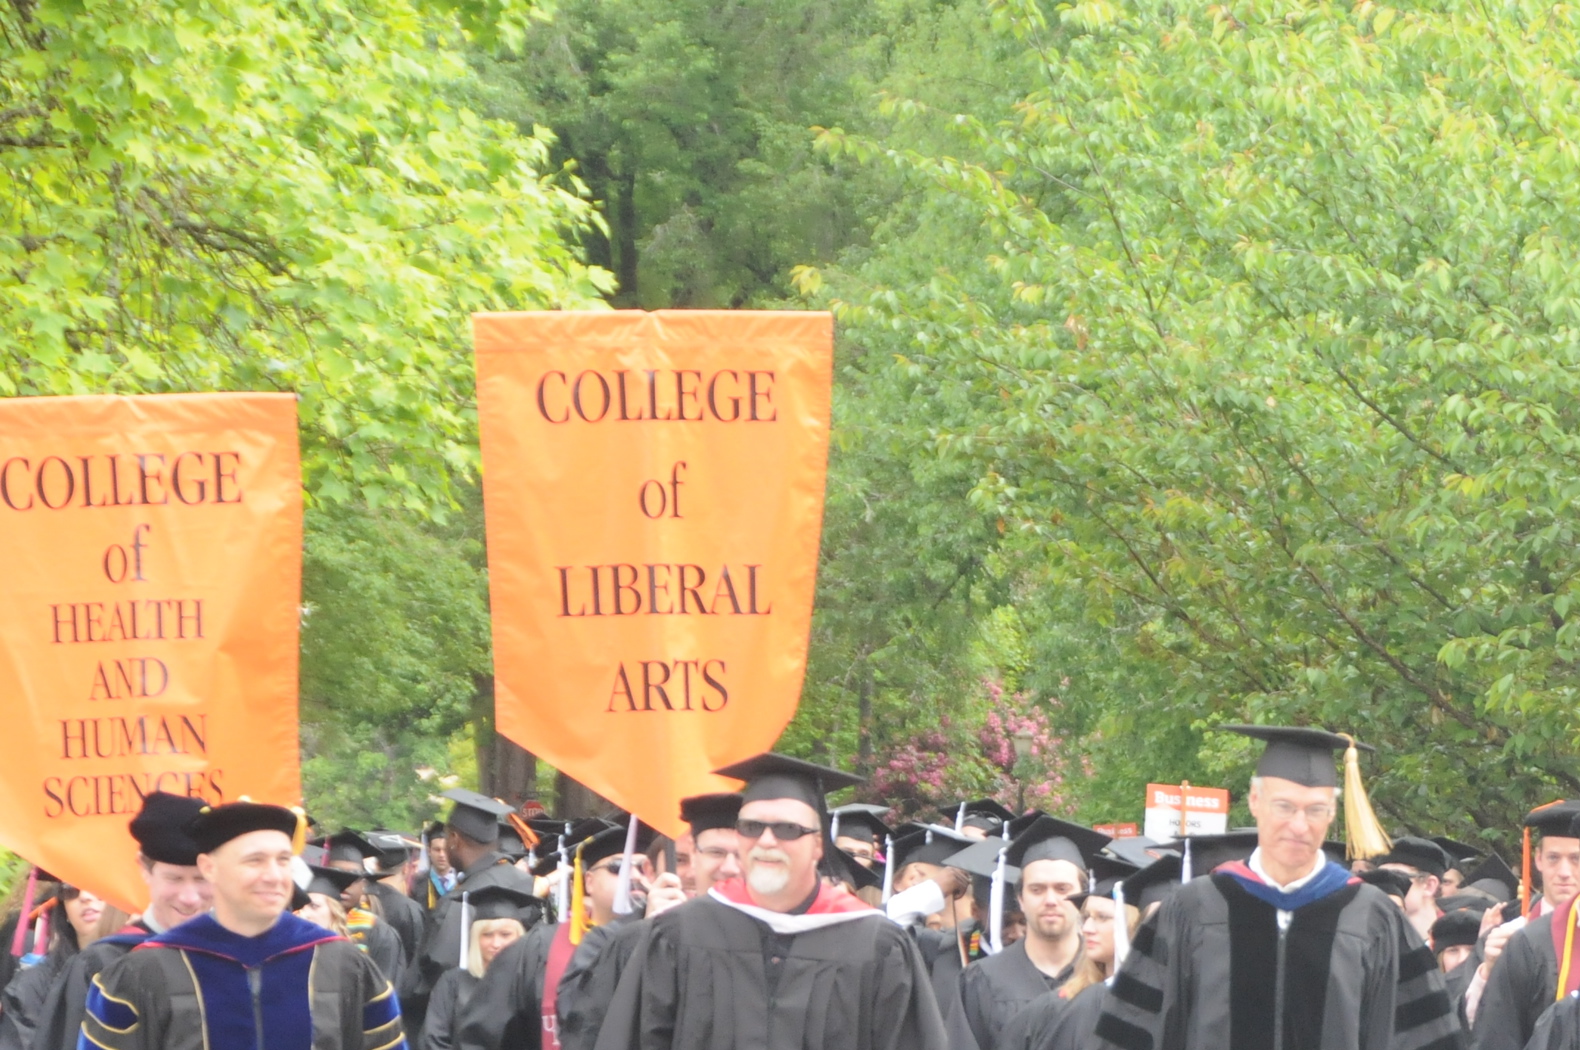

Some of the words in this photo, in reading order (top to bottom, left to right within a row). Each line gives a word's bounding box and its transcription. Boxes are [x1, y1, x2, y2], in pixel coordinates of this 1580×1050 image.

[534, 368, 778, 424] COLLEGE
[0, 451, 243, 511] COLLEGE
[637, 460, 688, 519] of
[102, 523, 152, 584] of
[554, 563, 773, 618] LIBERAL
[49, 598, 205, 645] HEALTH
[88, 656, 170, 702] AND
[604, 657, 729, 713] ARTS
[58, 713, 208, 761] HUMAN
[1154, 790, 1220, 808] Busness
[1169, 818, 1202, 828] HOORS
